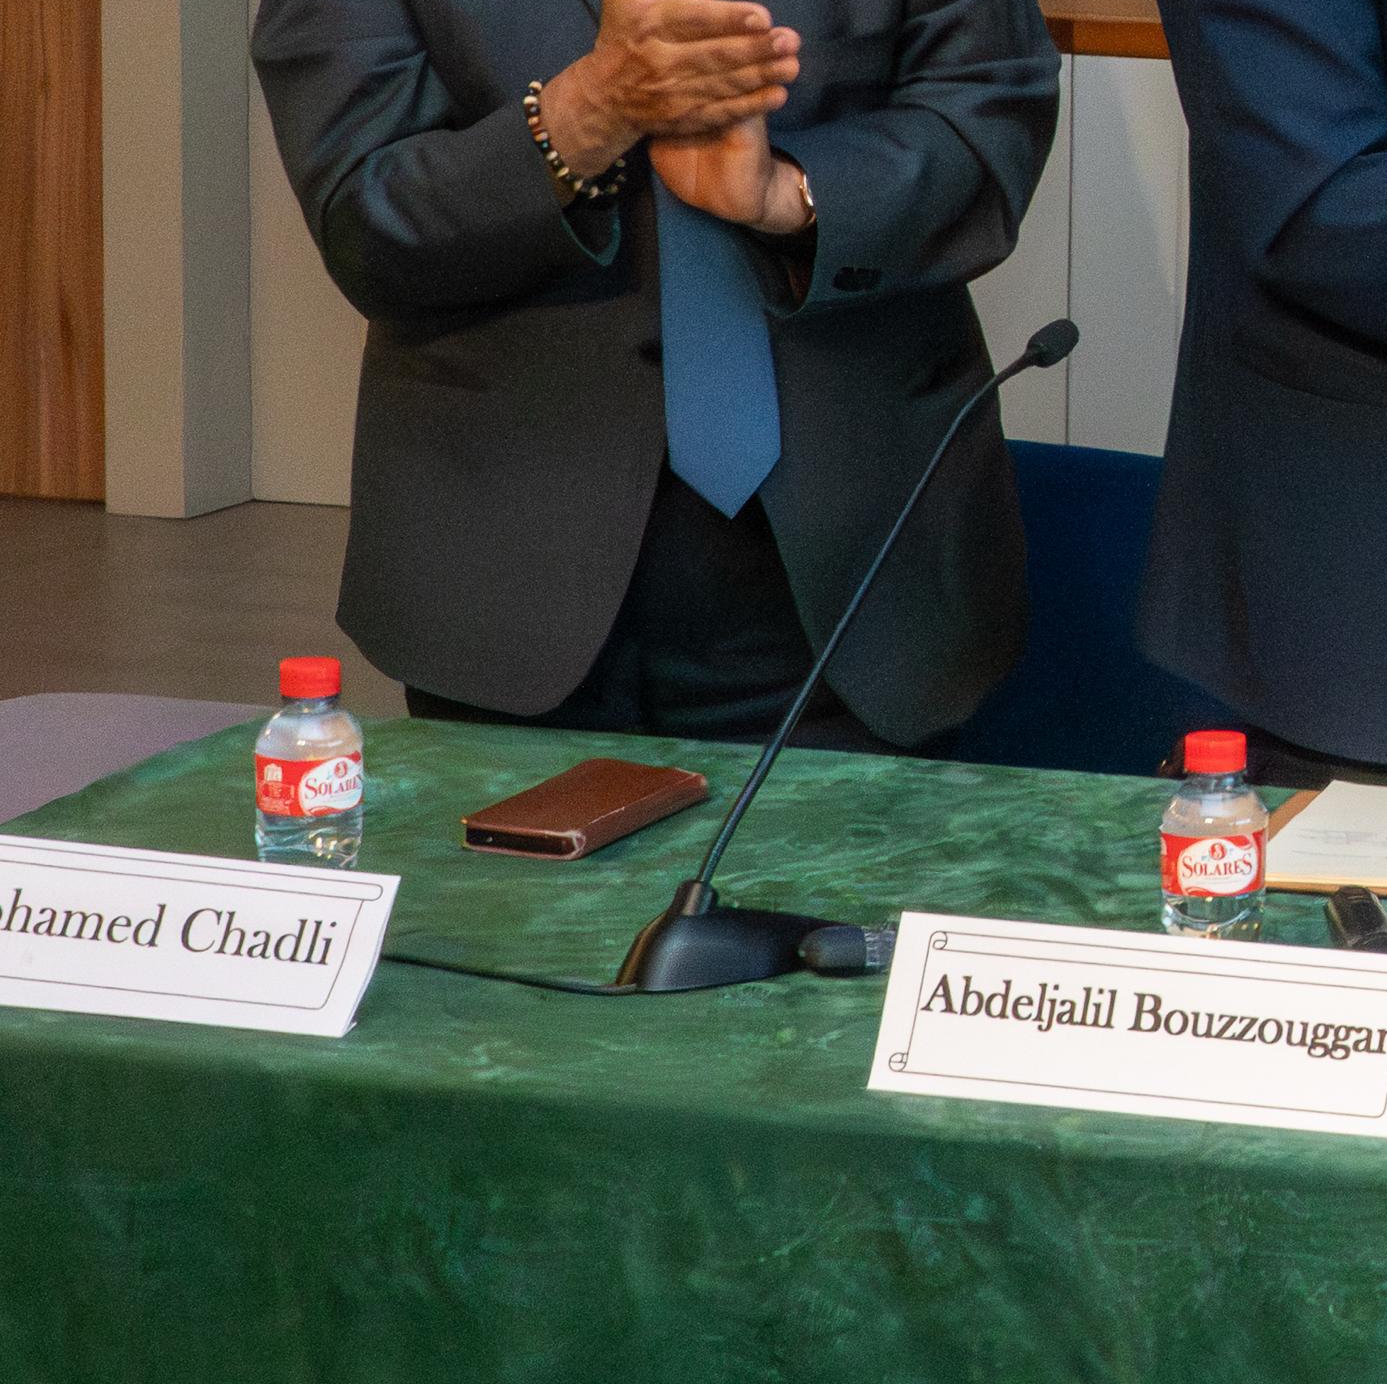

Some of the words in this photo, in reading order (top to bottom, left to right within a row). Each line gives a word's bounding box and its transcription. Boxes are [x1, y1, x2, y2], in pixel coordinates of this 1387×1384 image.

[1181, 852, 1253, 879] SOLARES
[0, 887, 167, 949] hamed
[180, 907, 338, 966] Chadli
[920, 973, 1118, 1033] Abdeljalil
